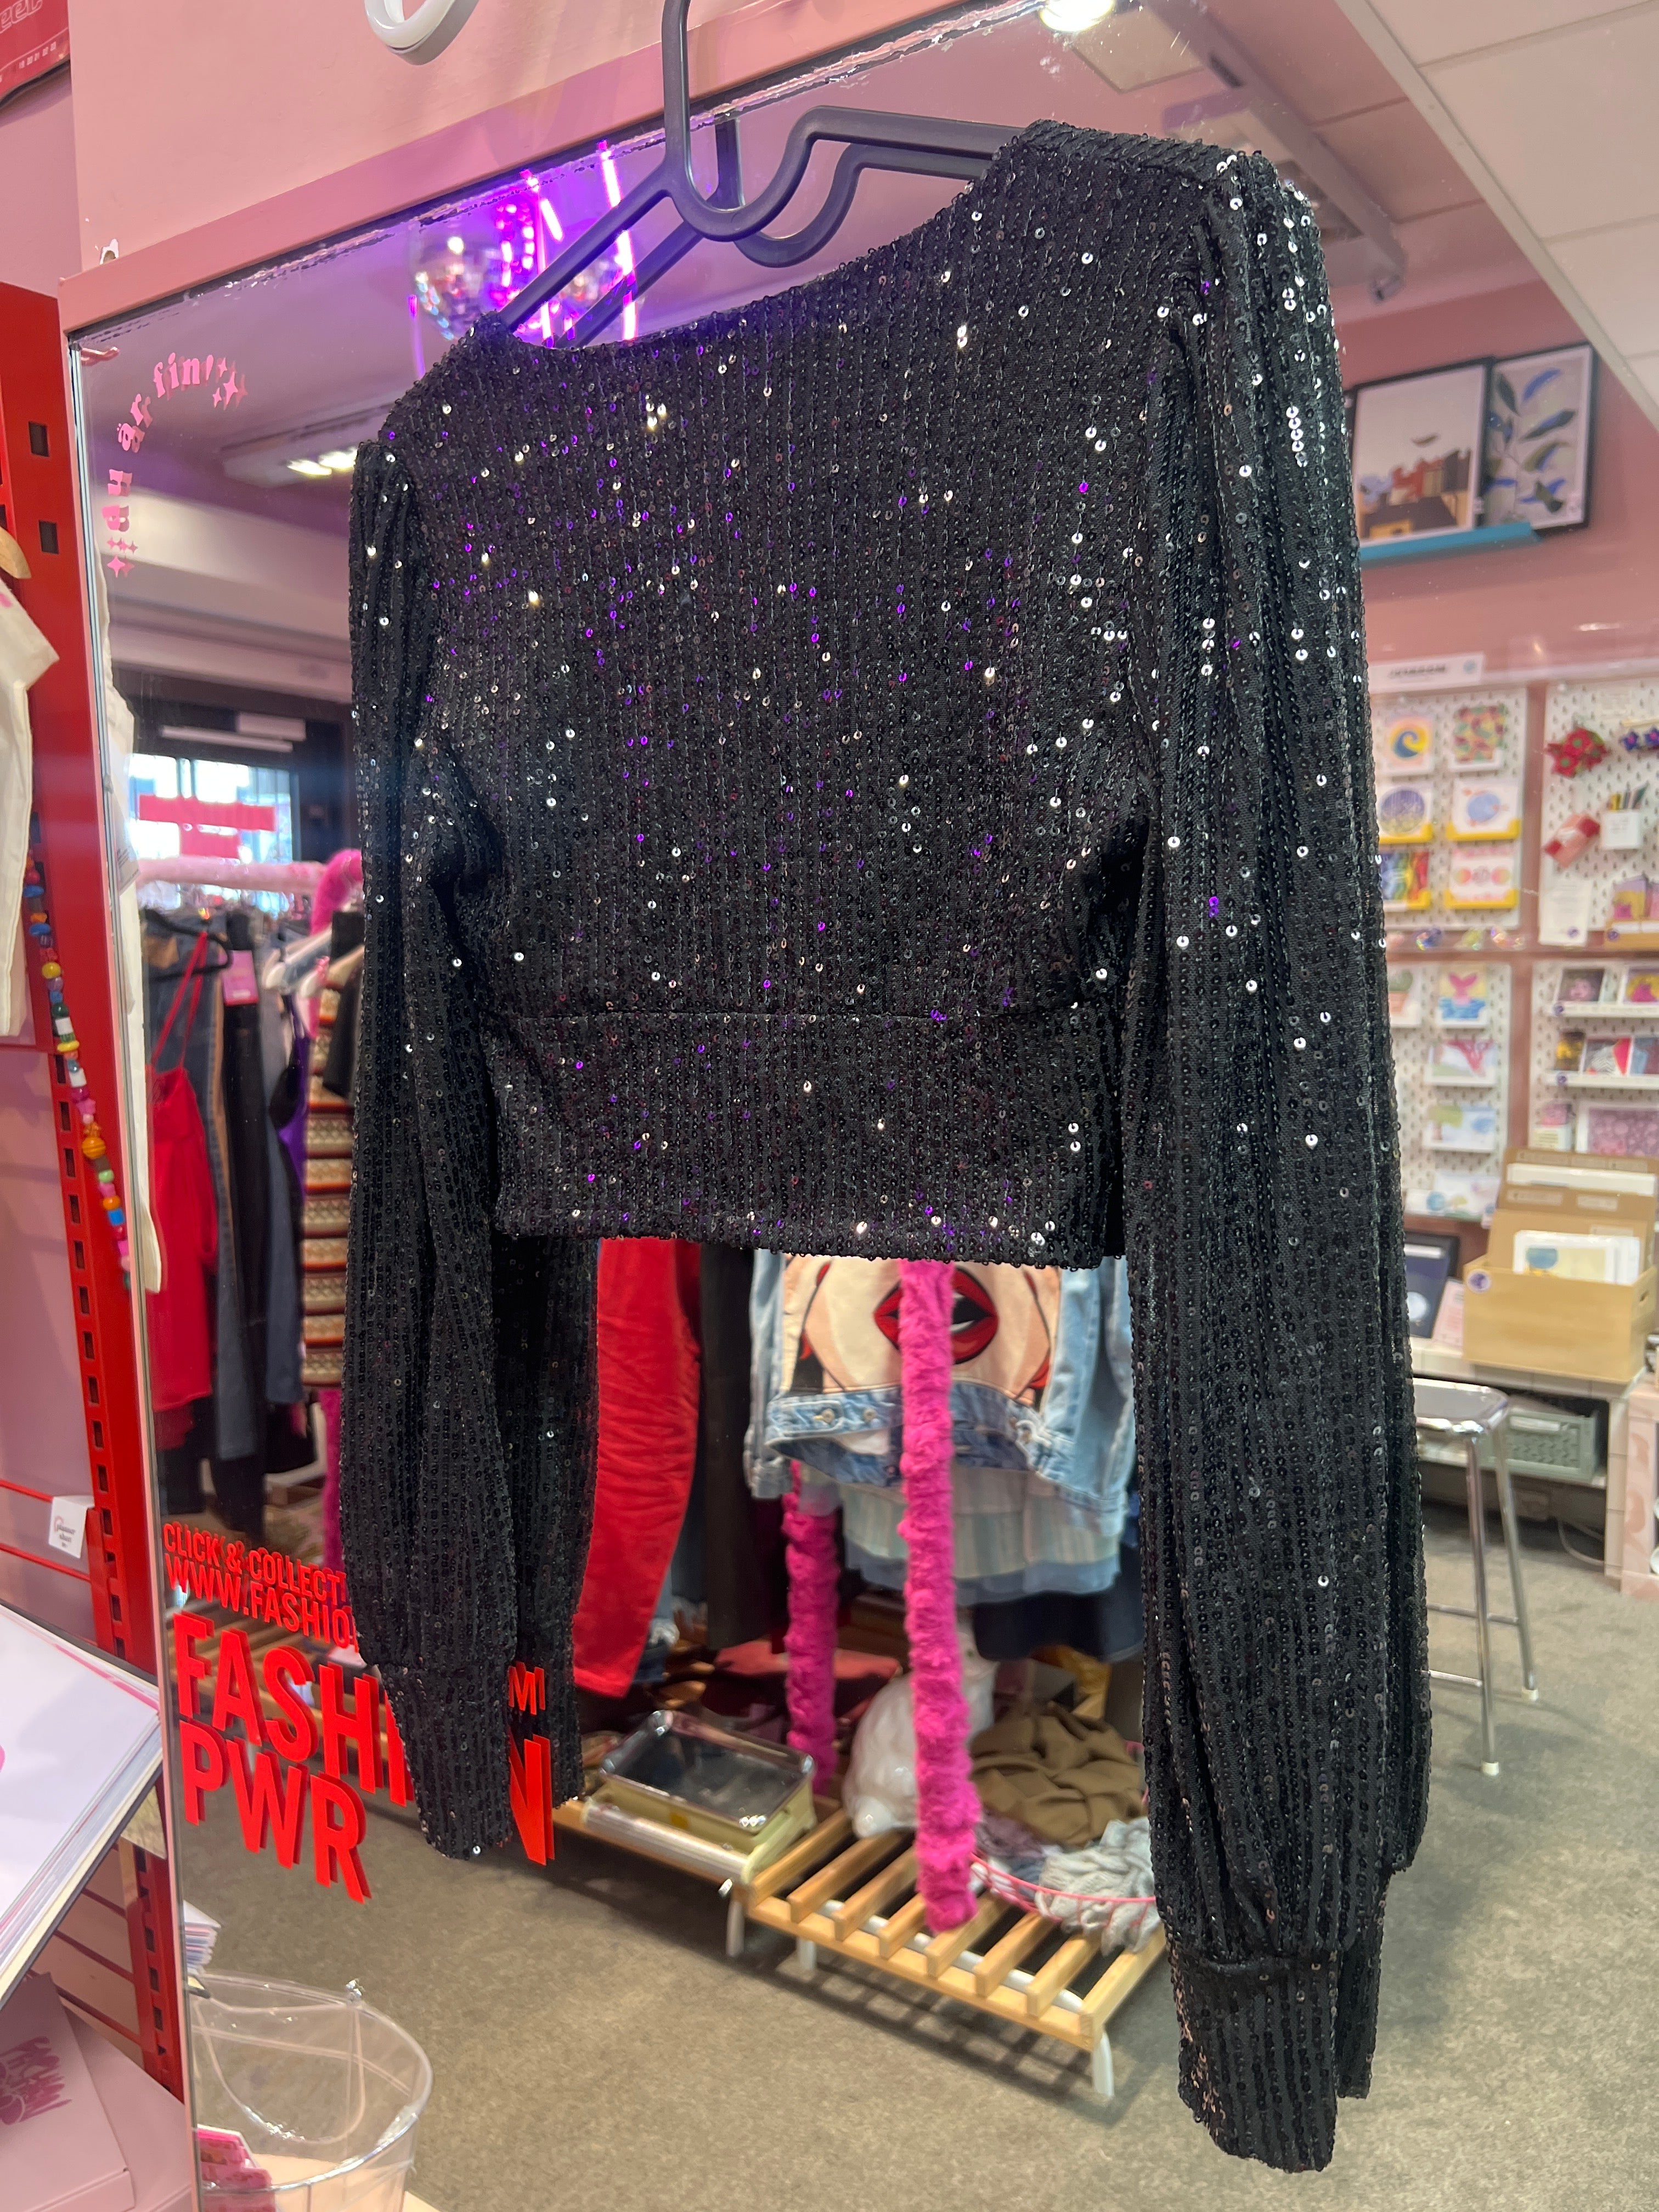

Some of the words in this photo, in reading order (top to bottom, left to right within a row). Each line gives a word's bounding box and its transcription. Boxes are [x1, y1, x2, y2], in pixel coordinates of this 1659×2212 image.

[164, 1523, 219, 1567] CLICK
[227, 1543, 242, 1575] &
[249, 1550, 340, 1605] COLLECT
[165, 1553, 358, 1652] WWW.FASHIO
[179, 1720, 365, 1904] PWR
